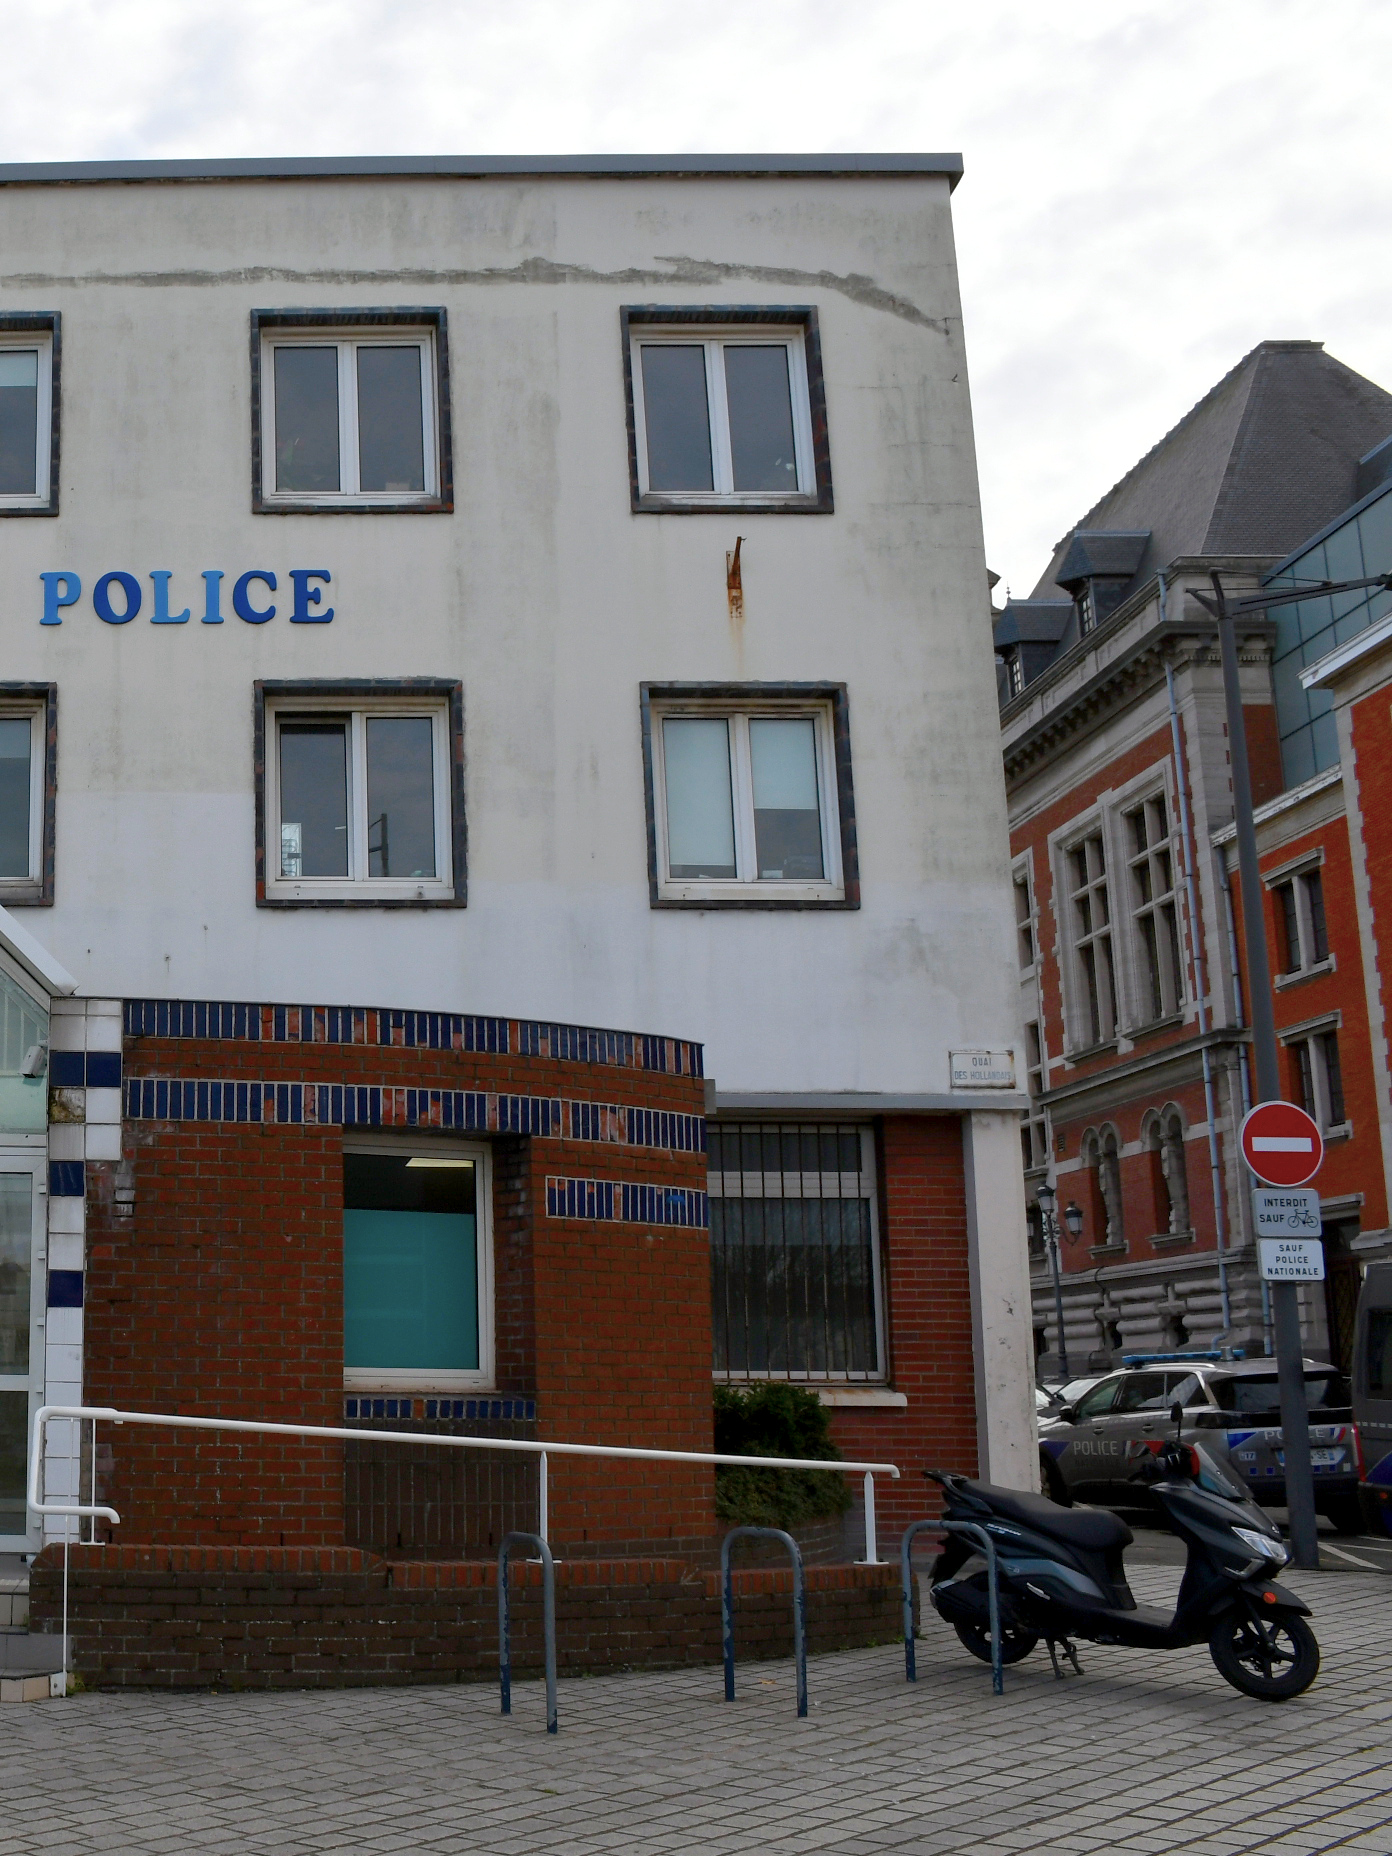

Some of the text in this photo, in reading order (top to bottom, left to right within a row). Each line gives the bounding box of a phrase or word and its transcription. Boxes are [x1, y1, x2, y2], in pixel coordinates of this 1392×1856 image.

[39, 569, 335, 625] POLICE
[971, 1057, 992, 1067] QUAI
[954, 1070, 1011, 1081] DES HOLLANDAIS
[1263, 1198, 1308, 1207] INTERDIT
[1259, 1214, 1285, 1223] SAUF
[1278, 1244, 1303, 1252] SAUF
[1275, 1255, 1309, 1264] POLICE
[1267, 1267, 1319, 1276] NATIONALE
[1073, 1440, 1119, 1456] POLICE
